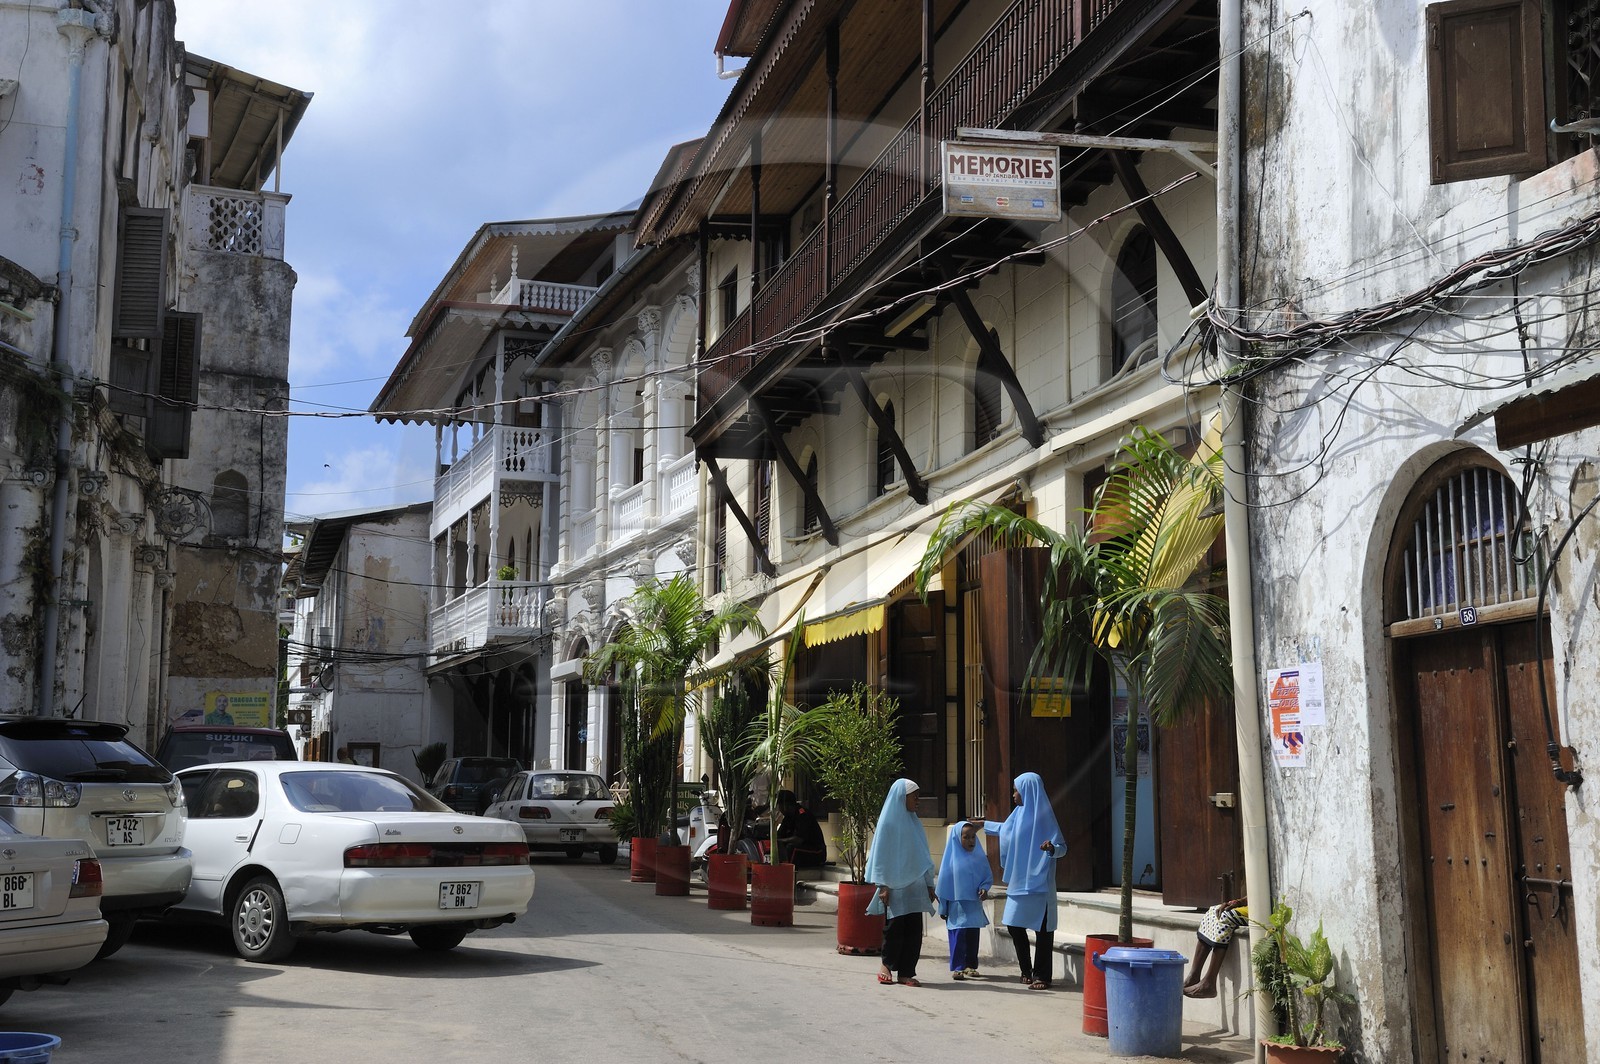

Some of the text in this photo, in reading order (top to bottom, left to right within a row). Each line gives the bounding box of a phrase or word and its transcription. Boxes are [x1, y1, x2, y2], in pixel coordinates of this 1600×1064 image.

[949, 154, 1054, 179] MEMORIES
[1463, 610, 1474, 623] 58
[205, 733, 254, 742] SUZUKI
[116, 819, 138, 831] Z 422
[123, 831, 133, 843] AS
[4, 875, 24, 892] 866
[449, 884, 472, 895] Z 862
[3, 892, 17, 908] BL
[455, 895, 466, 907] BN
